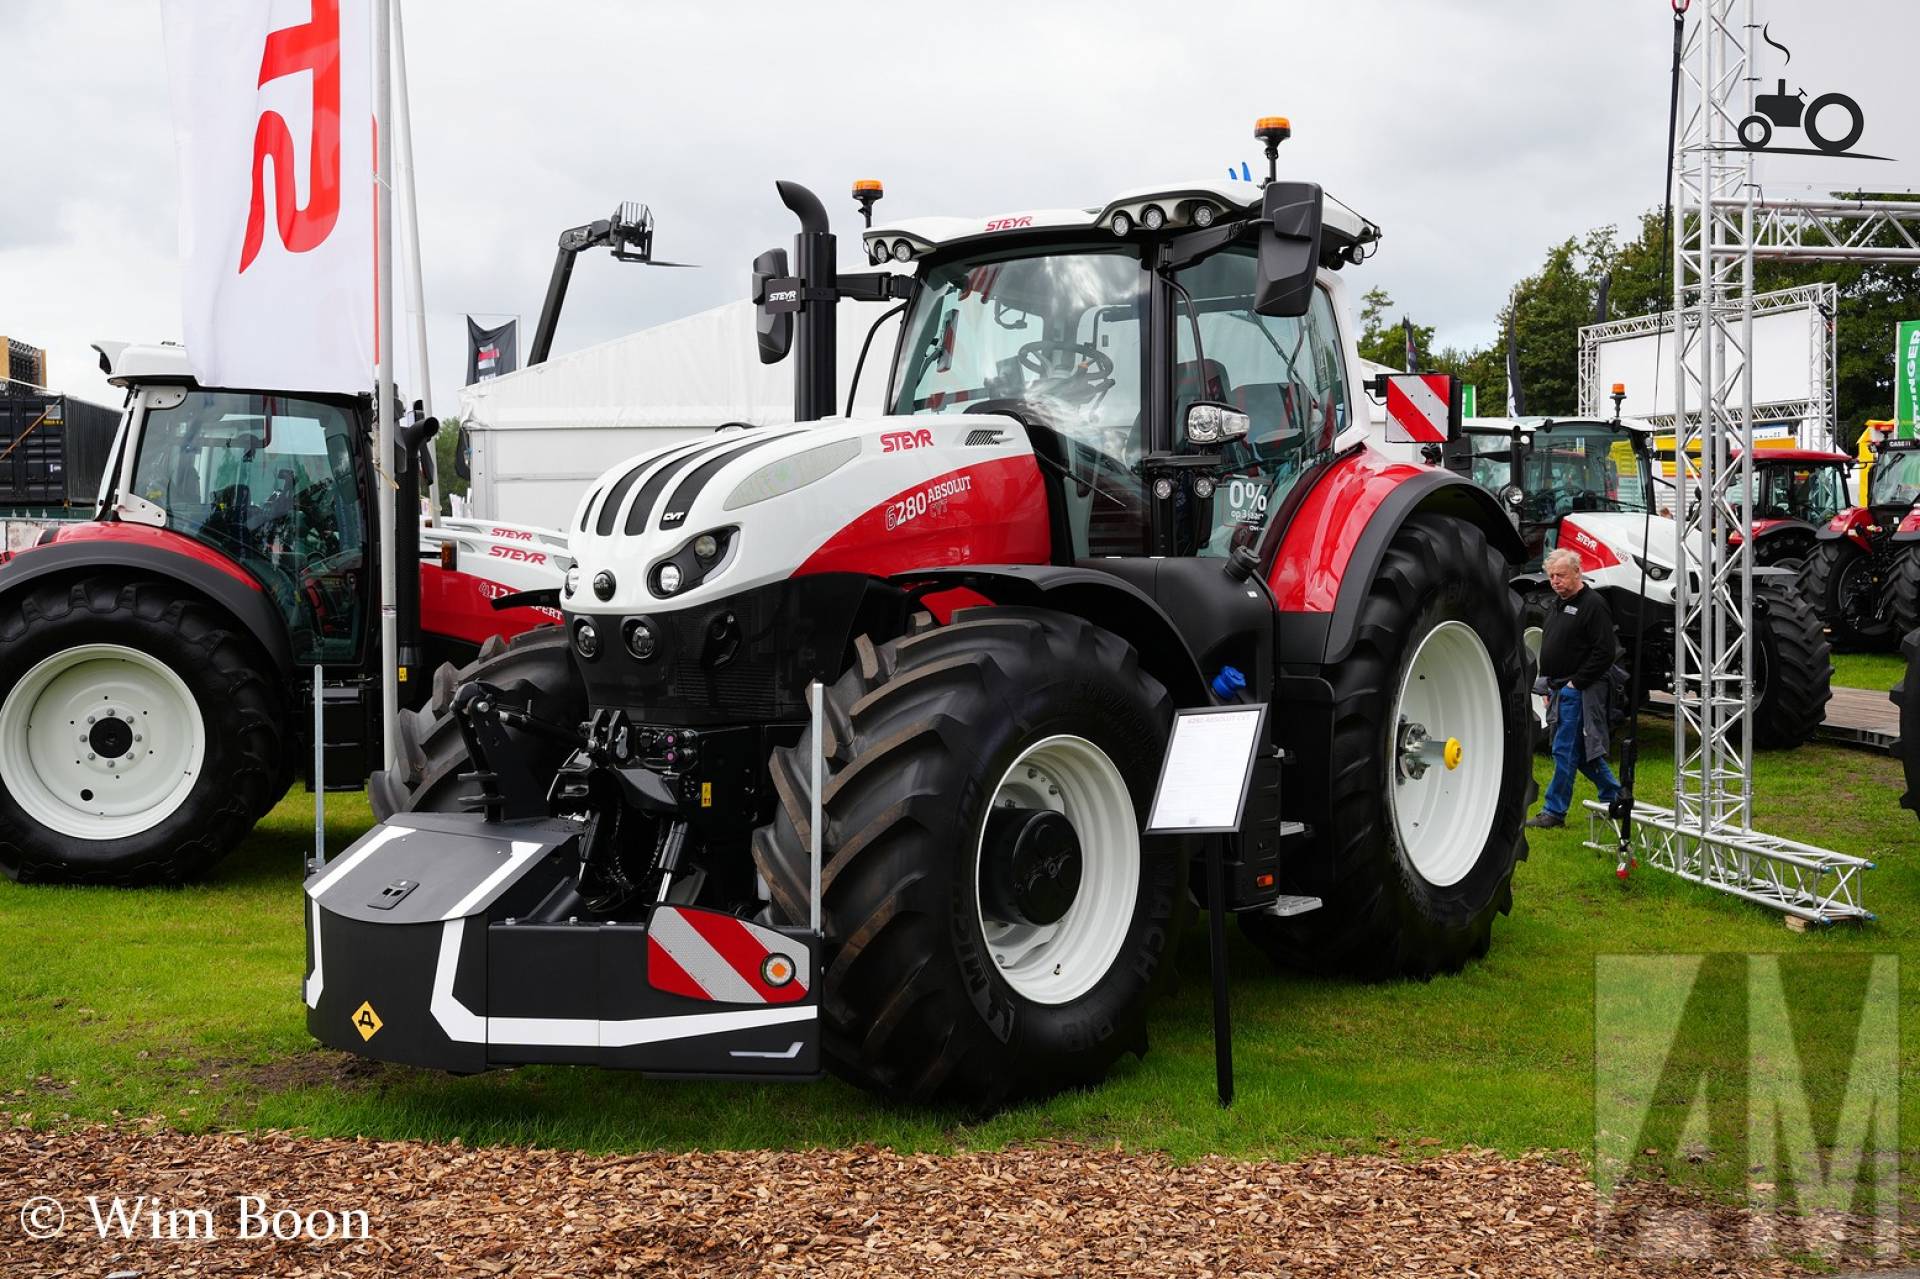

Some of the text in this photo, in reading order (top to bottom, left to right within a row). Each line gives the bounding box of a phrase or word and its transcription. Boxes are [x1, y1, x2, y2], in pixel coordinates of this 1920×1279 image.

[984, 215, 1033, 231] STEYR
[769, 290, 797, 302] STEYR
[880, 429, 934, 453] STEYR
[885, 476, 971, 532] 6280 ABSOLUT
[1229, 480, 1267, 511] 0%
[663, 511, 685, 521] CVT
[491, 527, 533, 542] STEYR
[1575, 532, 1598, 551] STEYR
[488, 545, 547, 565] STEYR
